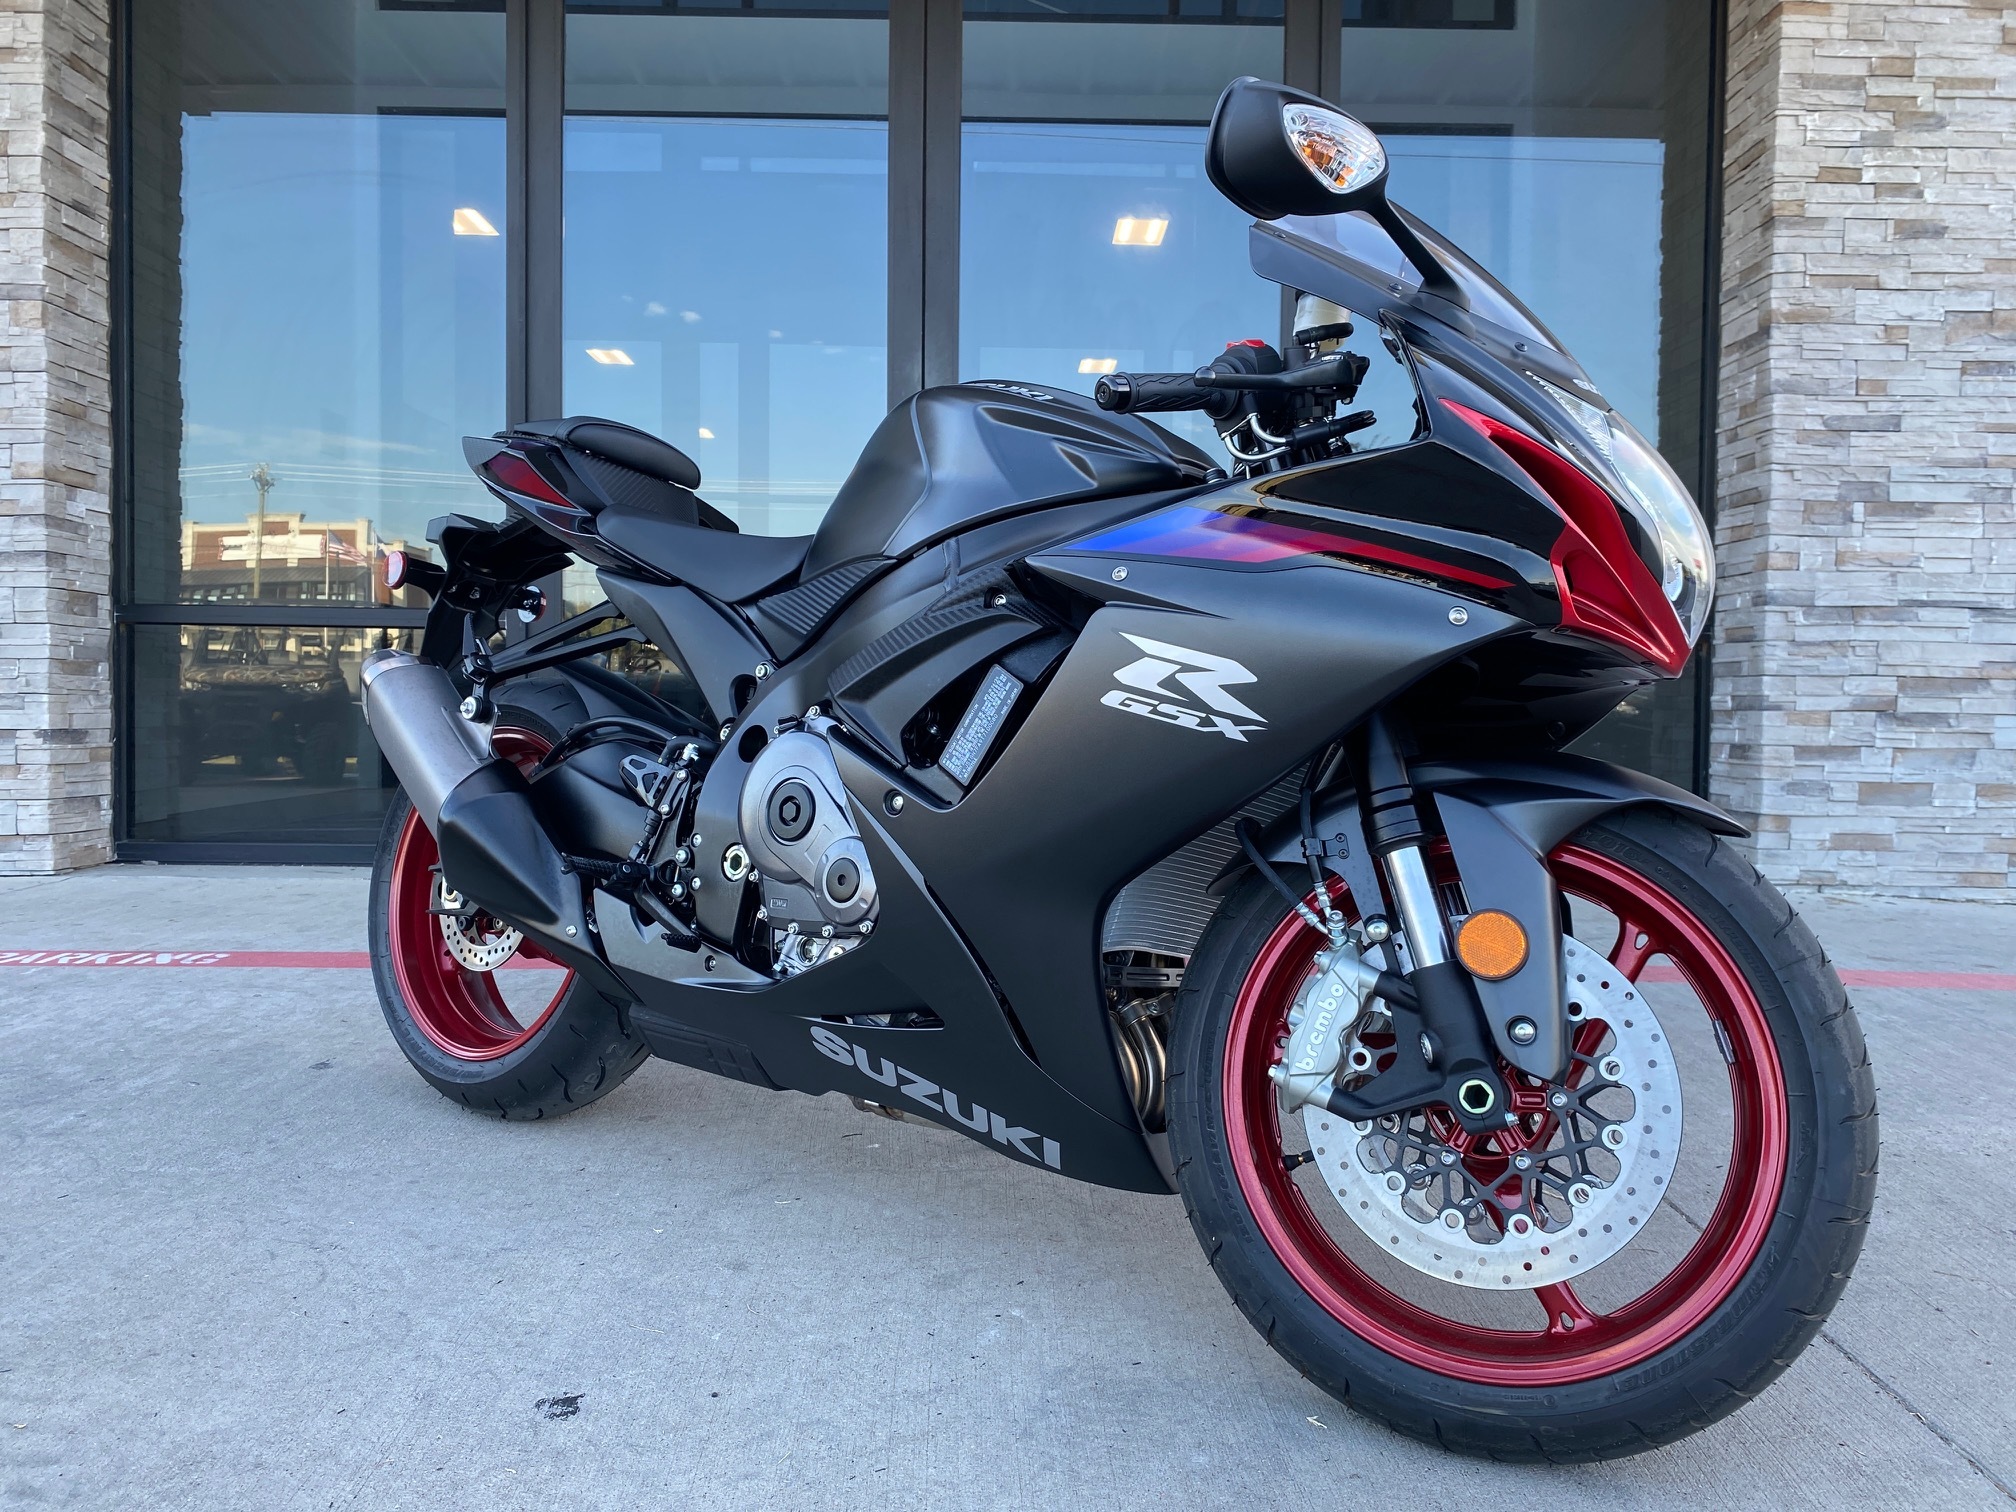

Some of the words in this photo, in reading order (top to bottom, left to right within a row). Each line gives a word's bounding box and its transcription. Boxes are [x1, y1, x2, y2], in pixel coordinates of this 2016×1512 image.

[1100, 690, 1268, 743] GSX
[1295, 983, 1344, 1071] brembo
[811, 1025, 1061, 1170] SUZUKI
